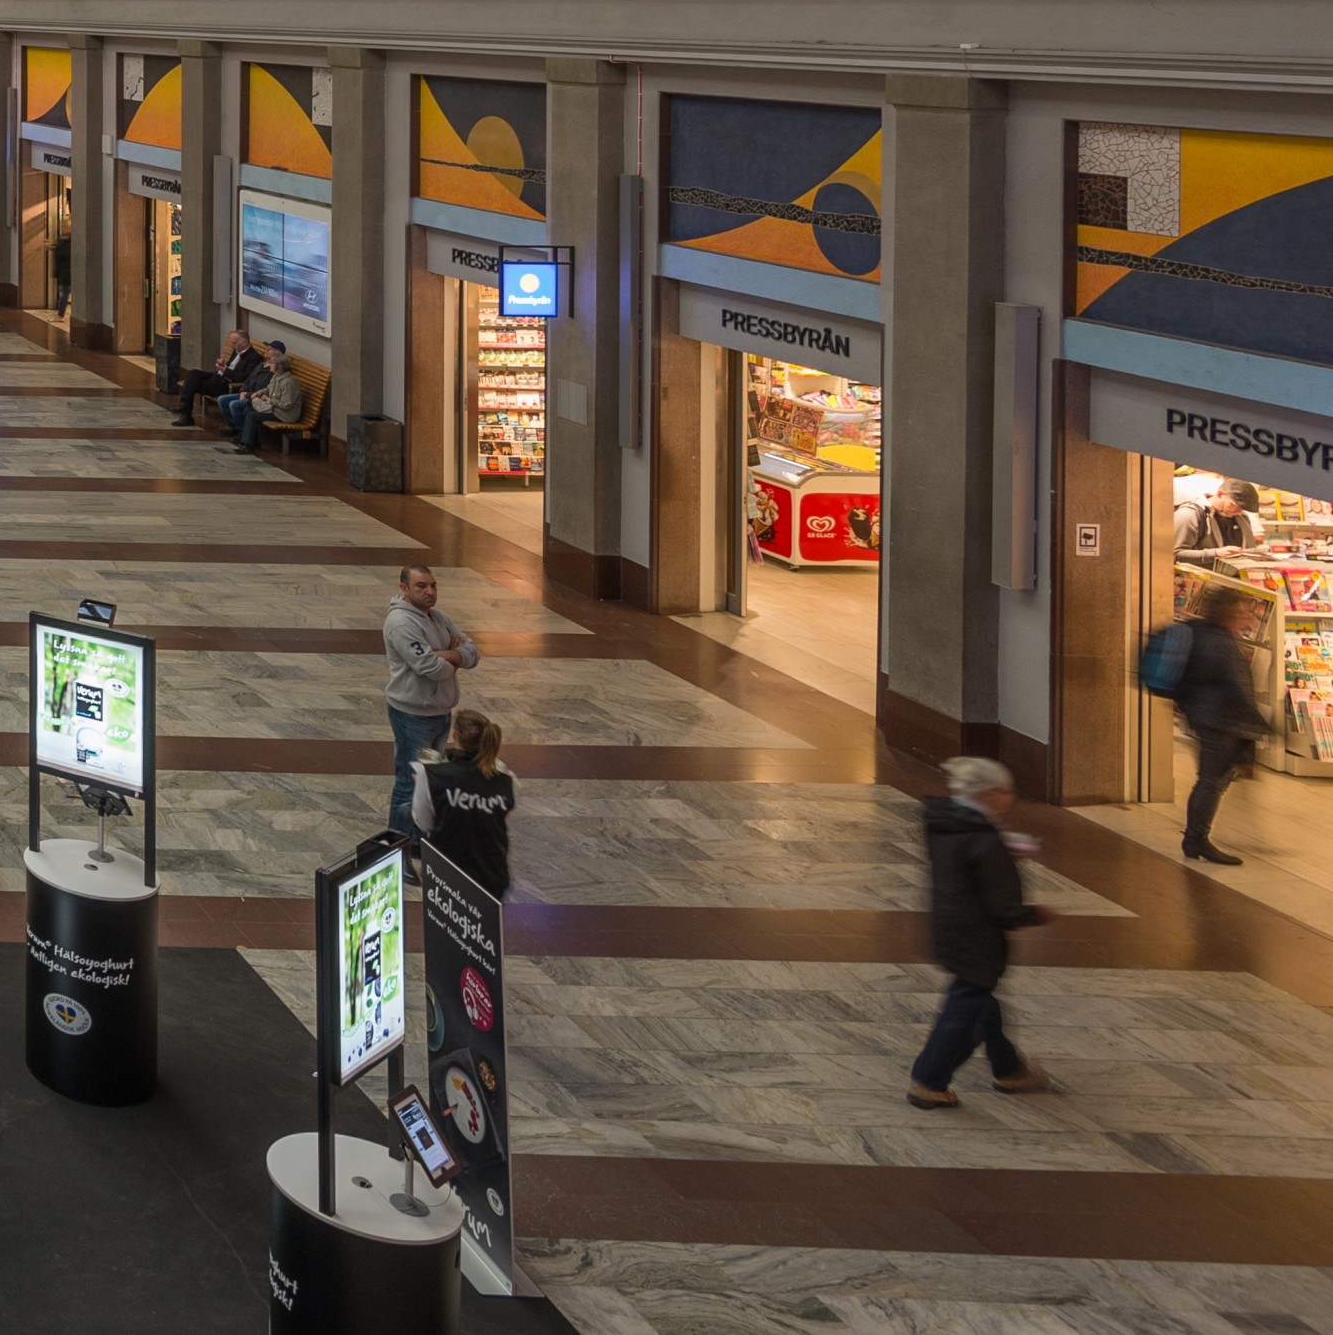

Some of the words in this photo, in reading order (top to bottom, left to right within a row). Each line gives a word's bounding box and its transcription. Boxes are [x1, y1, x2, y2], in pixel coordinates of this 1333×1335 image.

[721, 308, 851, 358] PRESSBYRÅN
[53, 639, 88, 655] Lyssna
[107, 652, 127, 664] gott
[53, 653, 71, 664] det
[410, 641, 425, 656] 3
[106, 726, 129, 739] eko
[446, 787, 507, 814] Verum
[426, 864, 467, 907] Provsmaka
[468, 901, 483, 920] vår
[427, 886, 496, 957] ekologiska
[30, 945, 67, 976] äntligen
[71, 967, 131, 989] ekologisk!
[54, 944, 134, 973] Hälsoyoghurt
